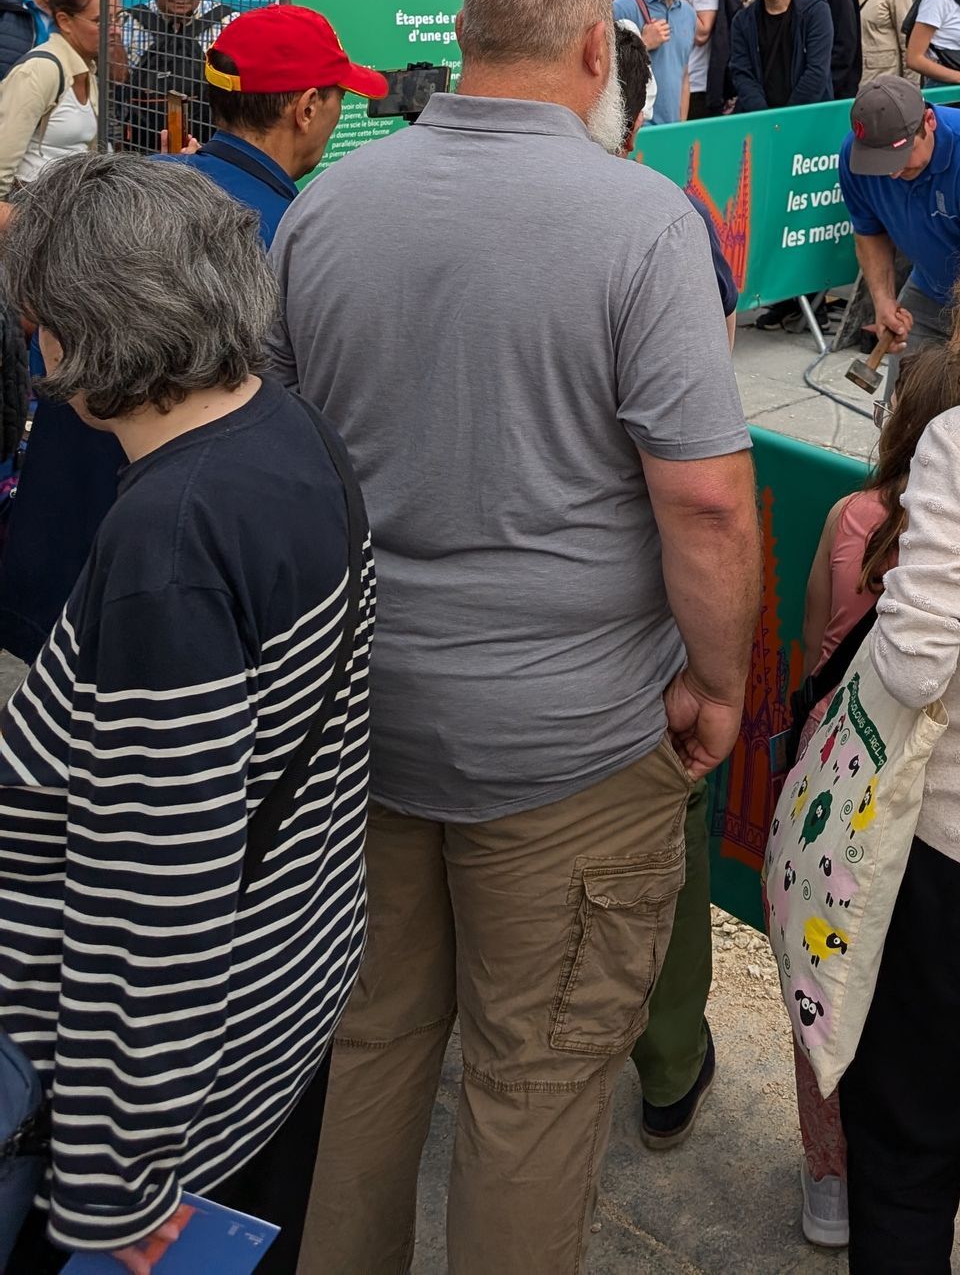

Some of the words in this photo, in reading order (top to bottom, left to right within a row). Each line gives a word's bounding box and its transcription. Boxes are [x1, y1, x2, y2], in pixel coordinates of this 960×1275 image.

[396, 10, 434, 28] Étapes
[436, 12, 450, 24] de
[341, 102, 354, 110] voir
[336, 130, 357, 139] donner
[372, 127, 390, 136] forme
[367, 119, 379, 127] bloc
[380, 119, 394, 129] pour
[792, 153, 839, 176] Recon
[787, 191, 808, 213] les
[811, 183, 845, 209] voû
[782, 226, 807, 249] les
